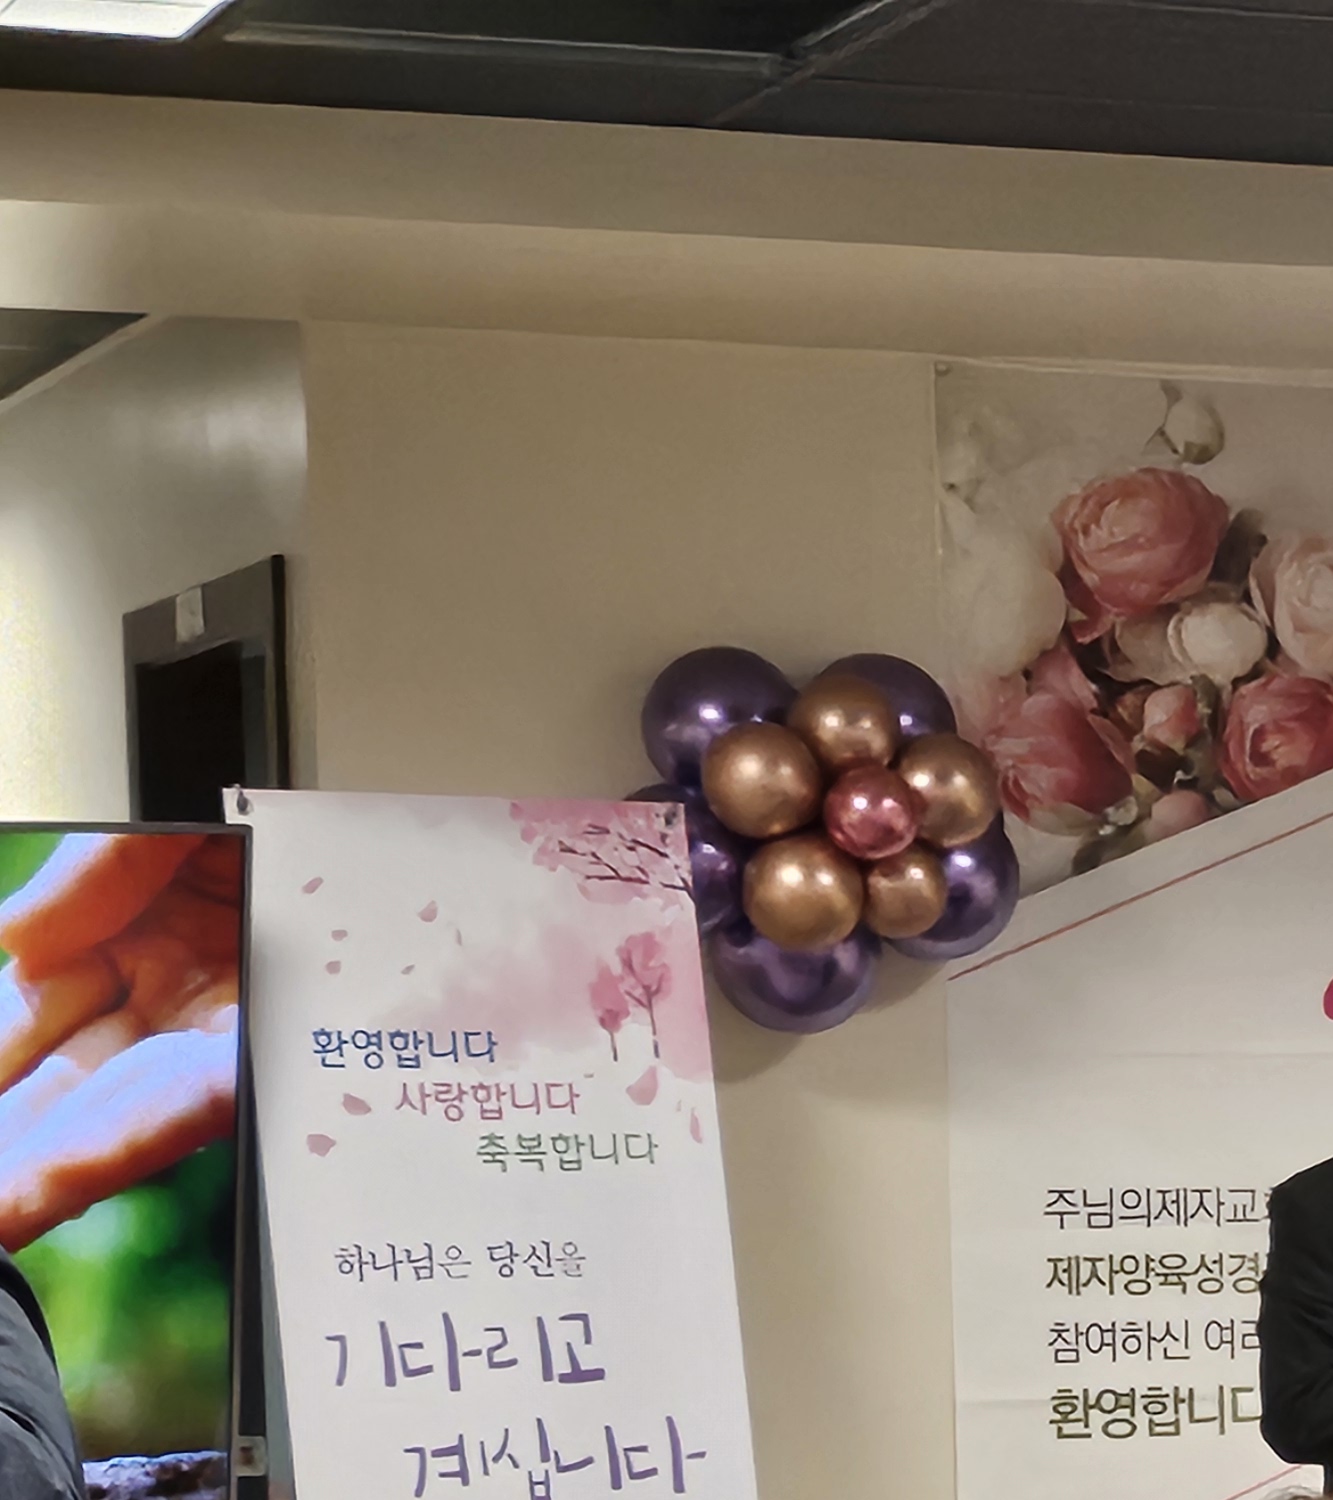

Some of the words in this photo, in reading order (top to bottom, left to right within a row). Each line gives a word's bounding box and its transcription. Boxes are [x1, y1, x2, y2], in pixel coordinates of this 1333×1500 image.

[312, 1028, 498, 1069] 환영합니다
[395, 1082, 580, 1122] 사랑합니다
[476, 1133, 658, 1172] 축복합니다
[1043, 1187, 1271, 1229] 주님의제자교
[334, 1242, 472, 1282] 하나님은
[487, 1240, 586, 1278] 당신을
[1045, 1252, 1266, 1296] 제자양육성경
[325, 1312, 606, 1392] 기다리고
[1048, 1319, 1191, 1364] 참여하신
